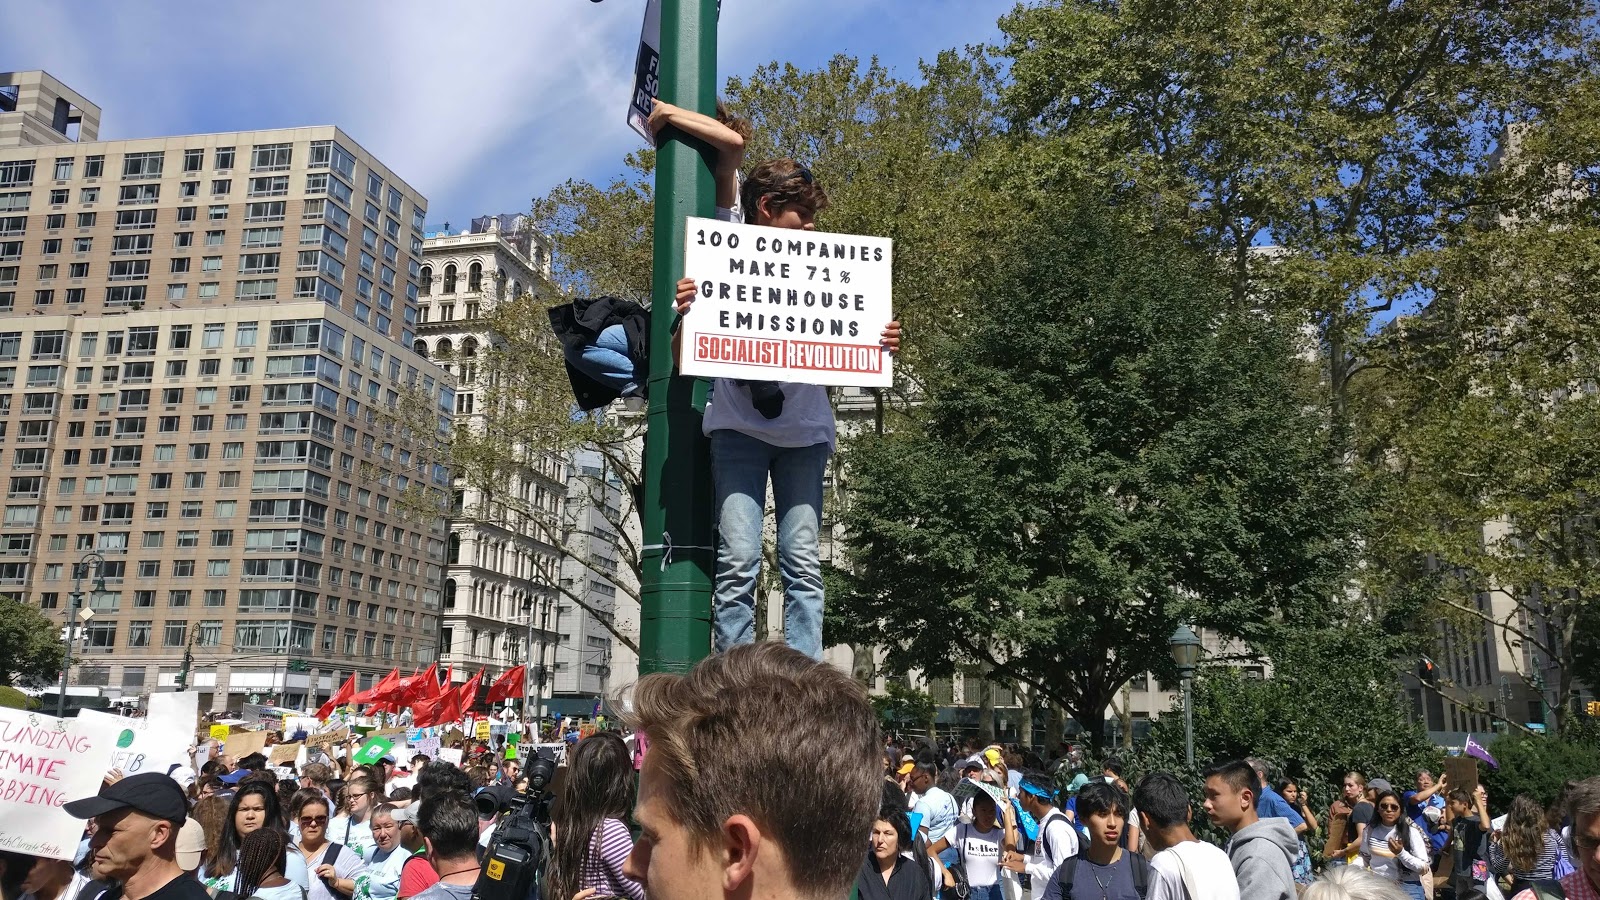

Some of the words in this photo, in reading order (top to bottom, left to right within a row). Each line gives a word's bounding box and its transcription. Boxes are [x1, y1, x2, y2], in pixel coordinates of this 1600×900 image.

[697, 229, 740, 249] 100
[756, 236, 883, 262] COMPANIES
[729, 258, 790, 279] MAKE
[701, 280, 864, 311] GREENHOUSE
[720, 310, 859, 337] EMISSIONS
[698, 336, 781, 365] SOCIALIST
[788, 344, 880, 371] REVOLUTION
